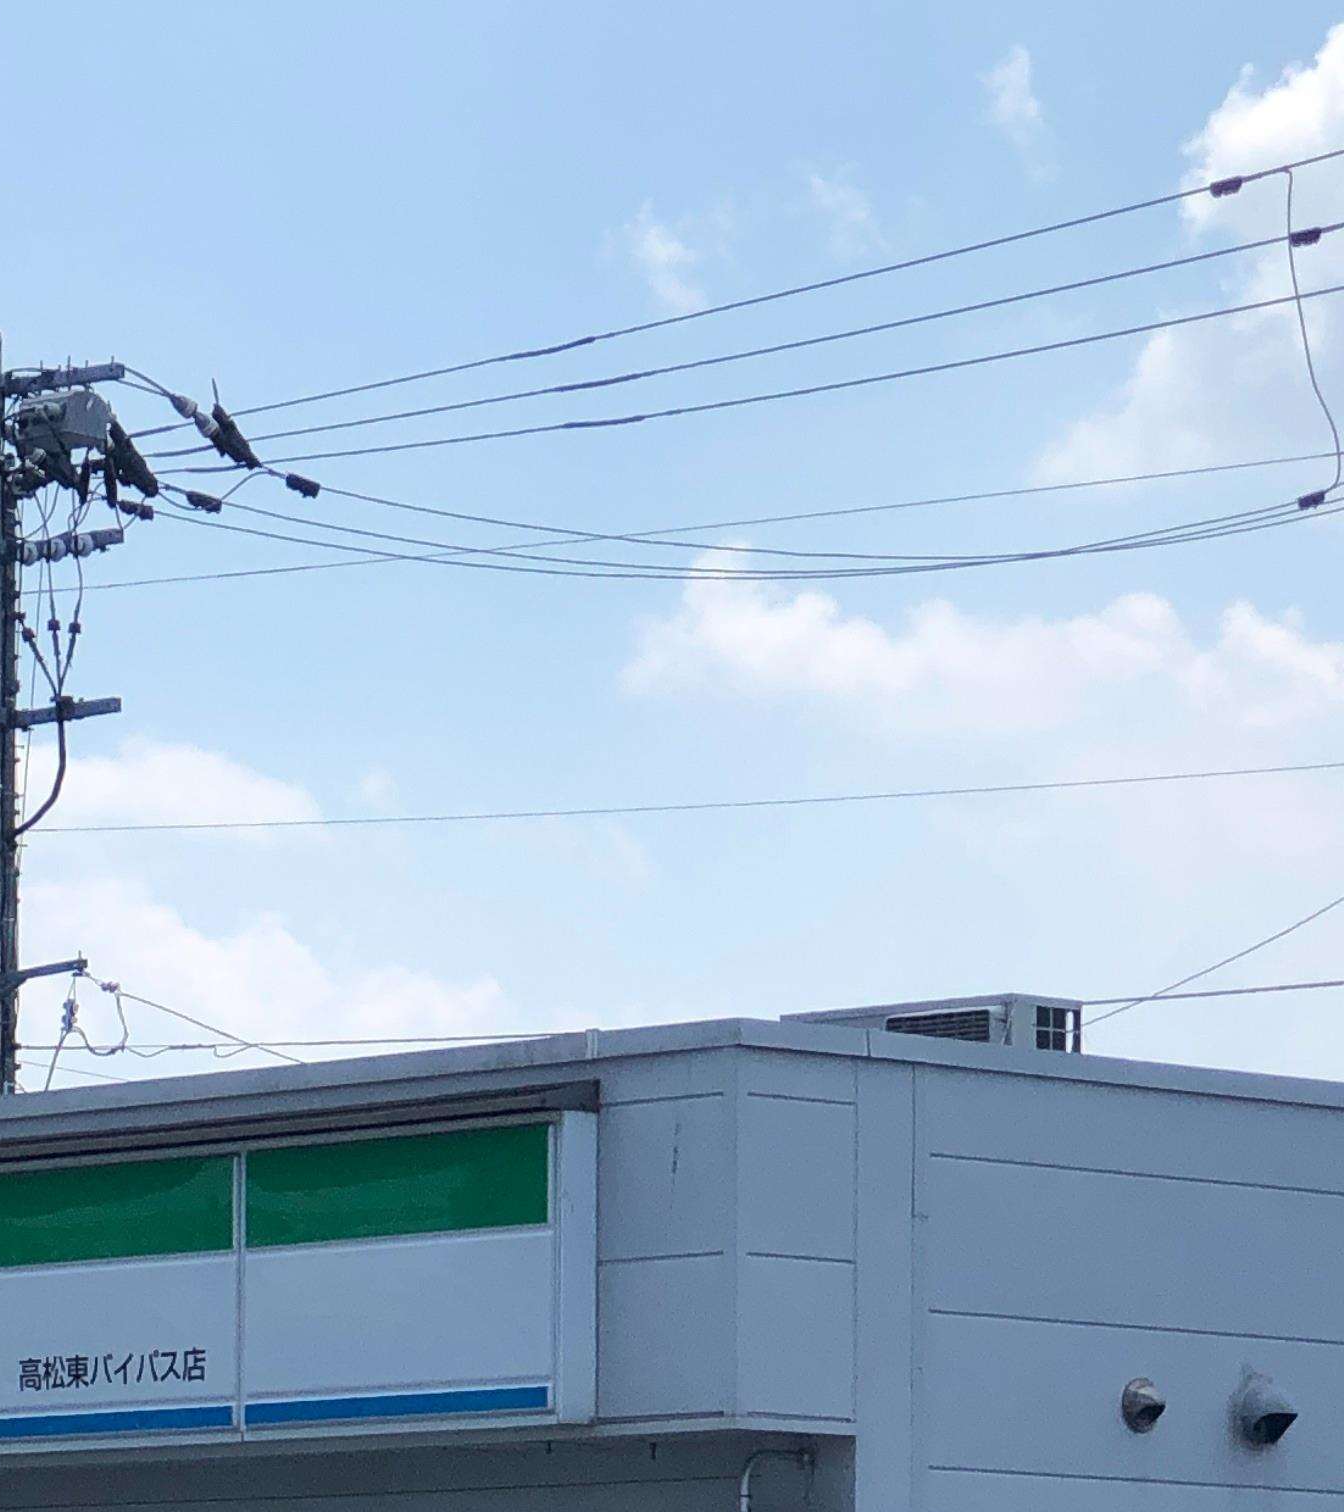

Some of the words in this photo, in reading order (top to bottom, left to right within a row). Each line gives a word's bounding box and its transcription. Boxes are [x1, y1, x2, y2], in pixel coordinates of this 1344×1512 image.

[18, 1347, 207, 1392] 高松東バイパス店
